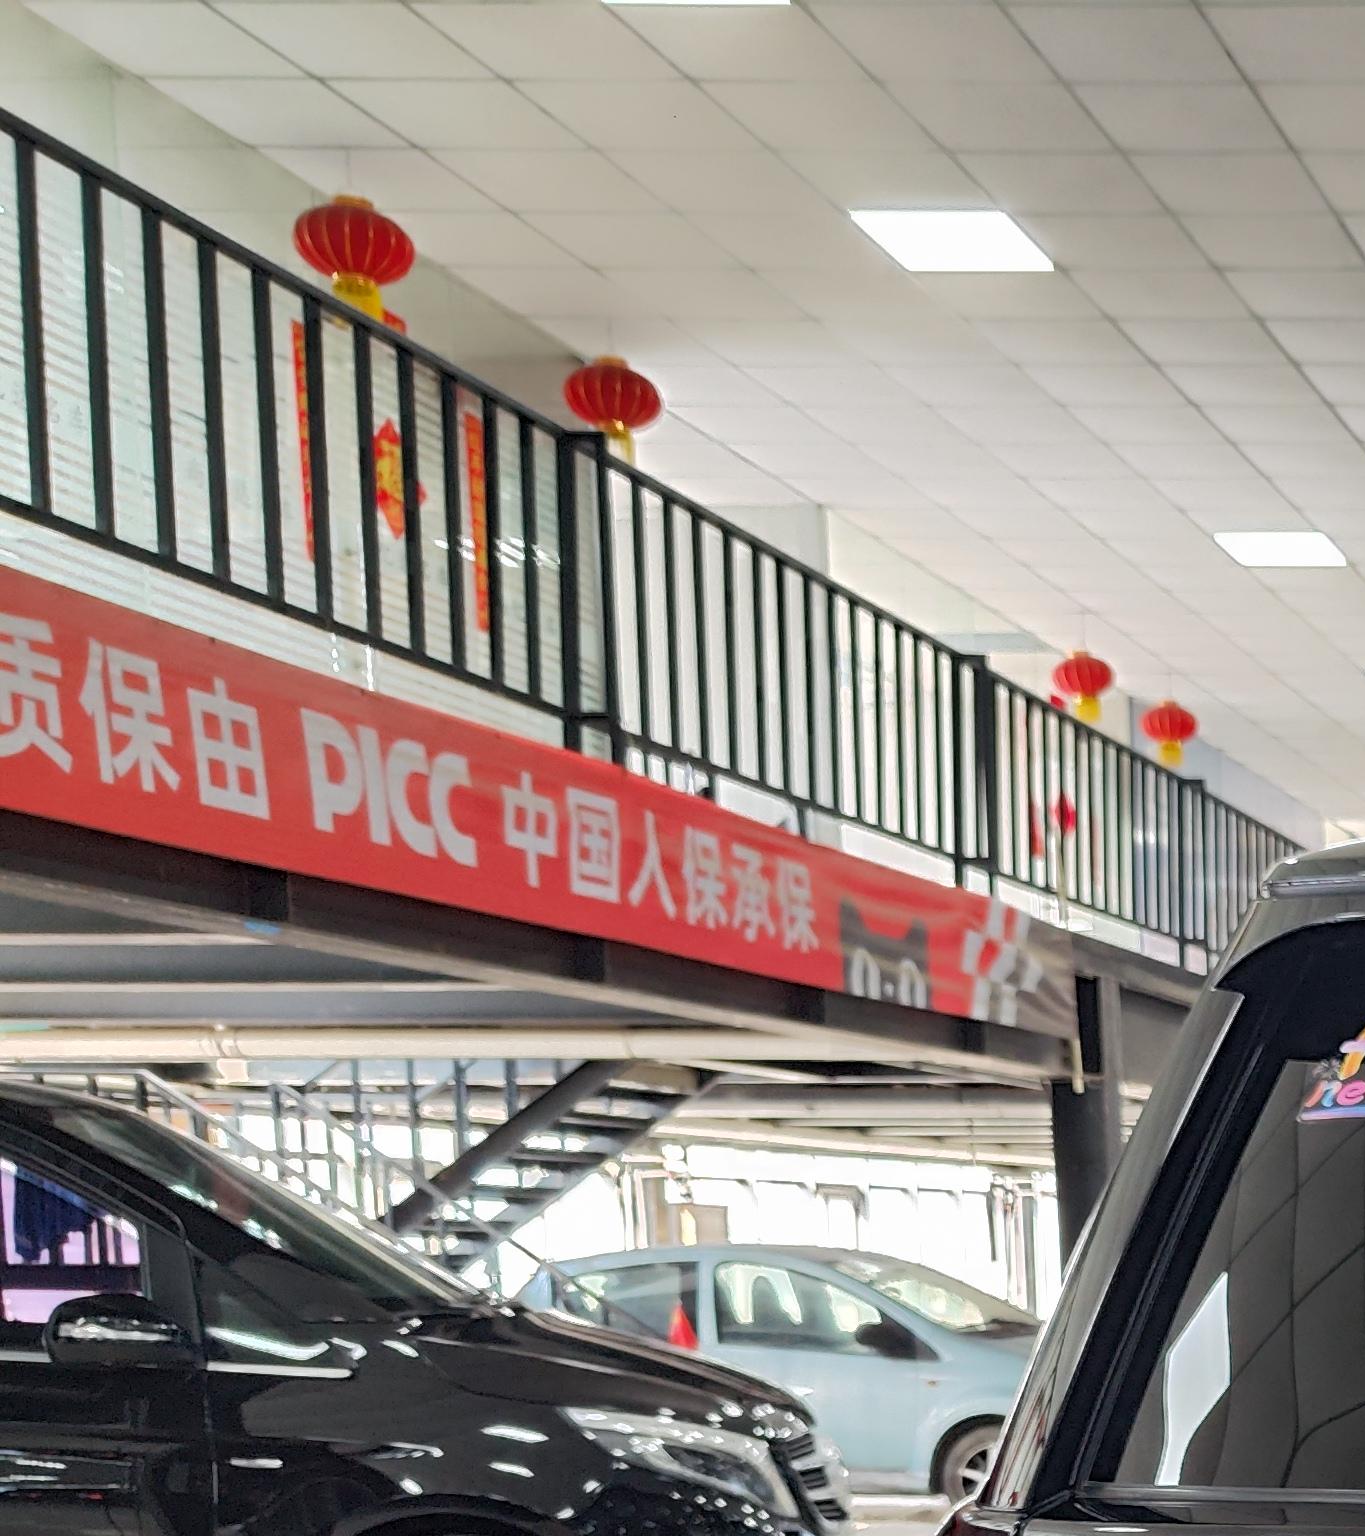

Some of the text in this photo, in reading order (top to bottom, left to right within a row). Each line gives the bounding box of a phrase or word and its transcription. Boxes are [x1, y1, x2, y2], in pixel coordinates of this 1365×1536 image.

[0, 611, 822, 954] 质保由 PICC 中国人保承保
